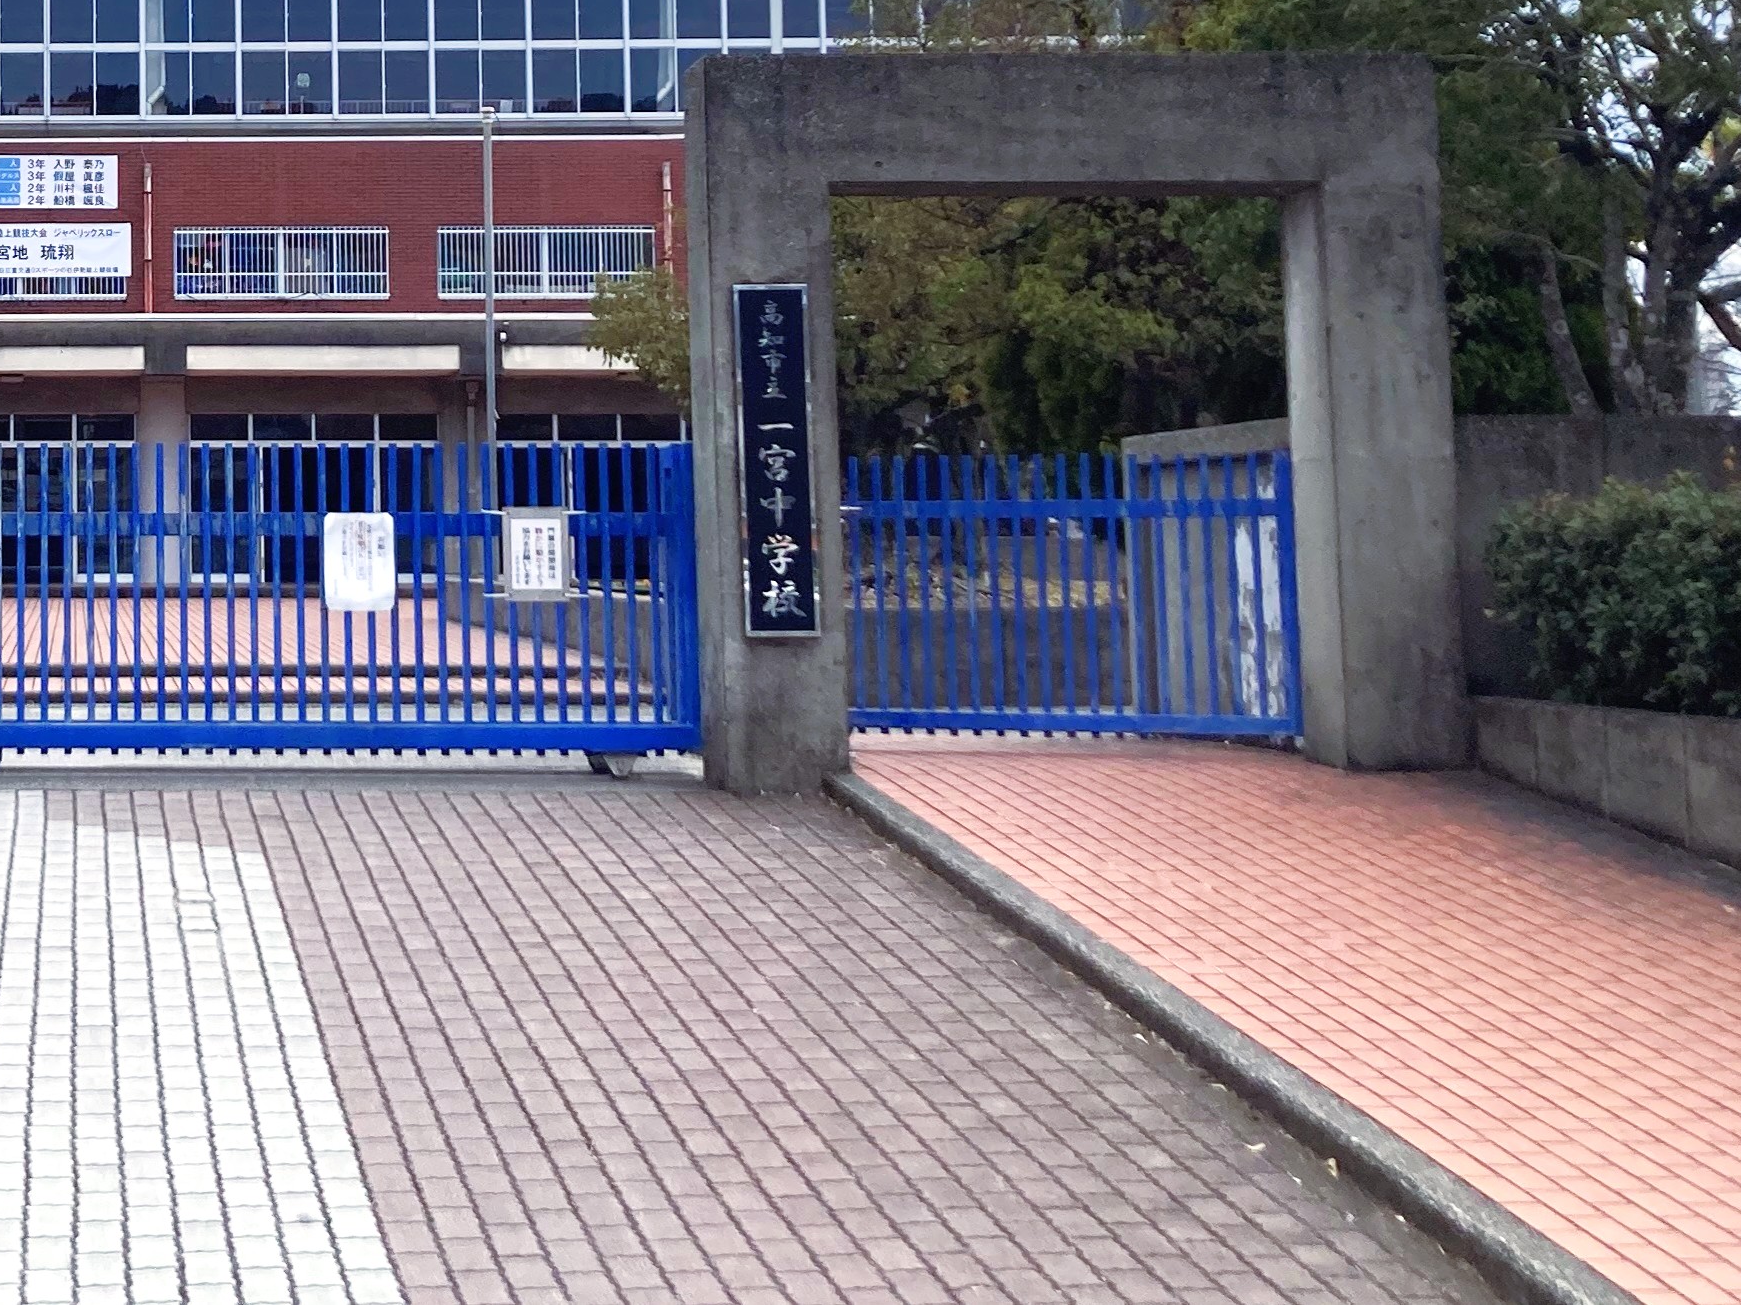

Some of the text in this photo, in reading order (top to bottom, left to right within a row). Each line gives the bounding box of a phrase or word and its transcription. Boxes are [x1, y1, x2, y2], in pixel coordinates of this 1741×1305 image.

[28, 159, 45, 169] 3年
[53, 159, 75, 169] 入野
[28, 172, 45, 181] 3年
[28, 184, 45, 193] 2年
[53, 184, 75, 193] 川村
[28, 195, 45, 205] 2年
